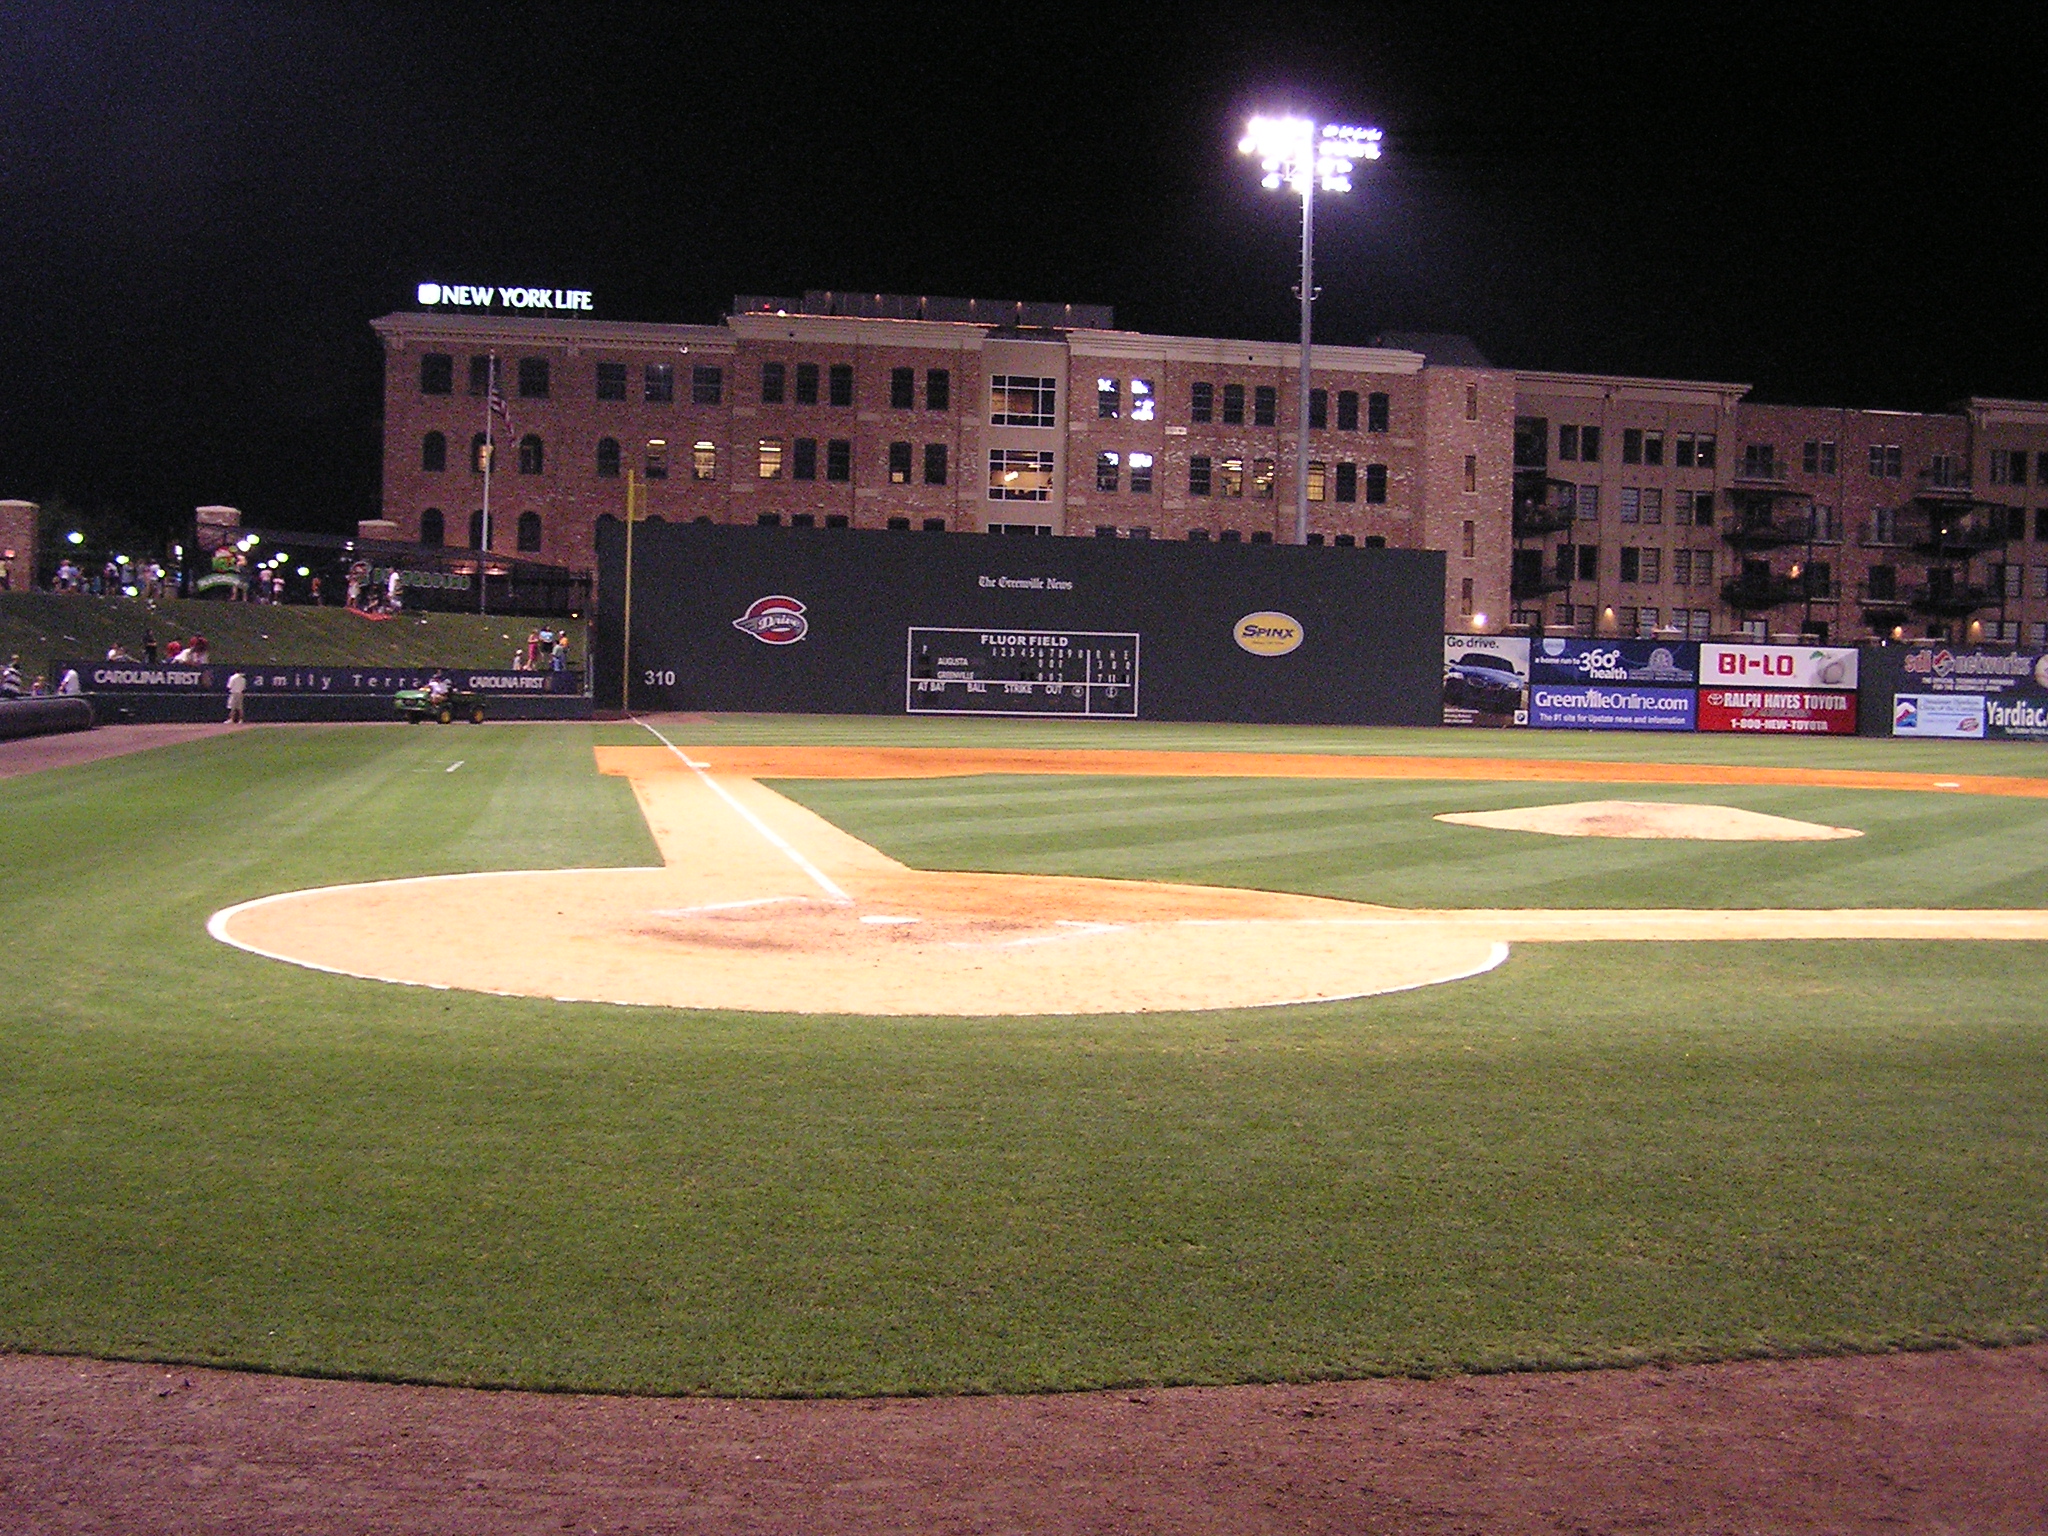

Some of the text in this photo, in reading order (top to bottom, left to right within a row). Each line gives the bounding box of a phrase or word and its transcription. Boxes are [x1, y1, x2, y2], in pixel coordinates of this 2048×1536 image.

[442, 285, 594, 310] NEW YORK LIFE
[979, 575, 1073, 590] The Greenville News
[758, 614, 800, 630] Drive
[980, 635, 1069, 647] FLUOR FIELD
[1447, 636, 1500, 648] Go drive.
[1001, 647, 1006, 657] 2
[1010, 647, 1015, 657] 3
[1718, 653, 1793, 676] BI-LO
[1955, 651, 2032, 676] networks
[94, 669, 201, 685] CAROLINA FIRST
[644, 670, 676, 686] 310
[1590, 666, 1628, 680] health
[253, 673, 452, 690] amily Terrae
[469, 676, 544, 689] CAROLINA FIRST
[967, 682, 987, 693] BALL
[1004, 684, 1033, 693] STRIKE
[1045, 684, 1063, 694] OUT
[1535, 690, 1688, 711] GreenvilleOnline.com
[1723, 693, 1847, 710] RALPH HAYES TOYOTA
[1540, 713, 1552, 721] The
[1577, 714, 1588, 722] for
[1634, 715, 1646, 723] and
